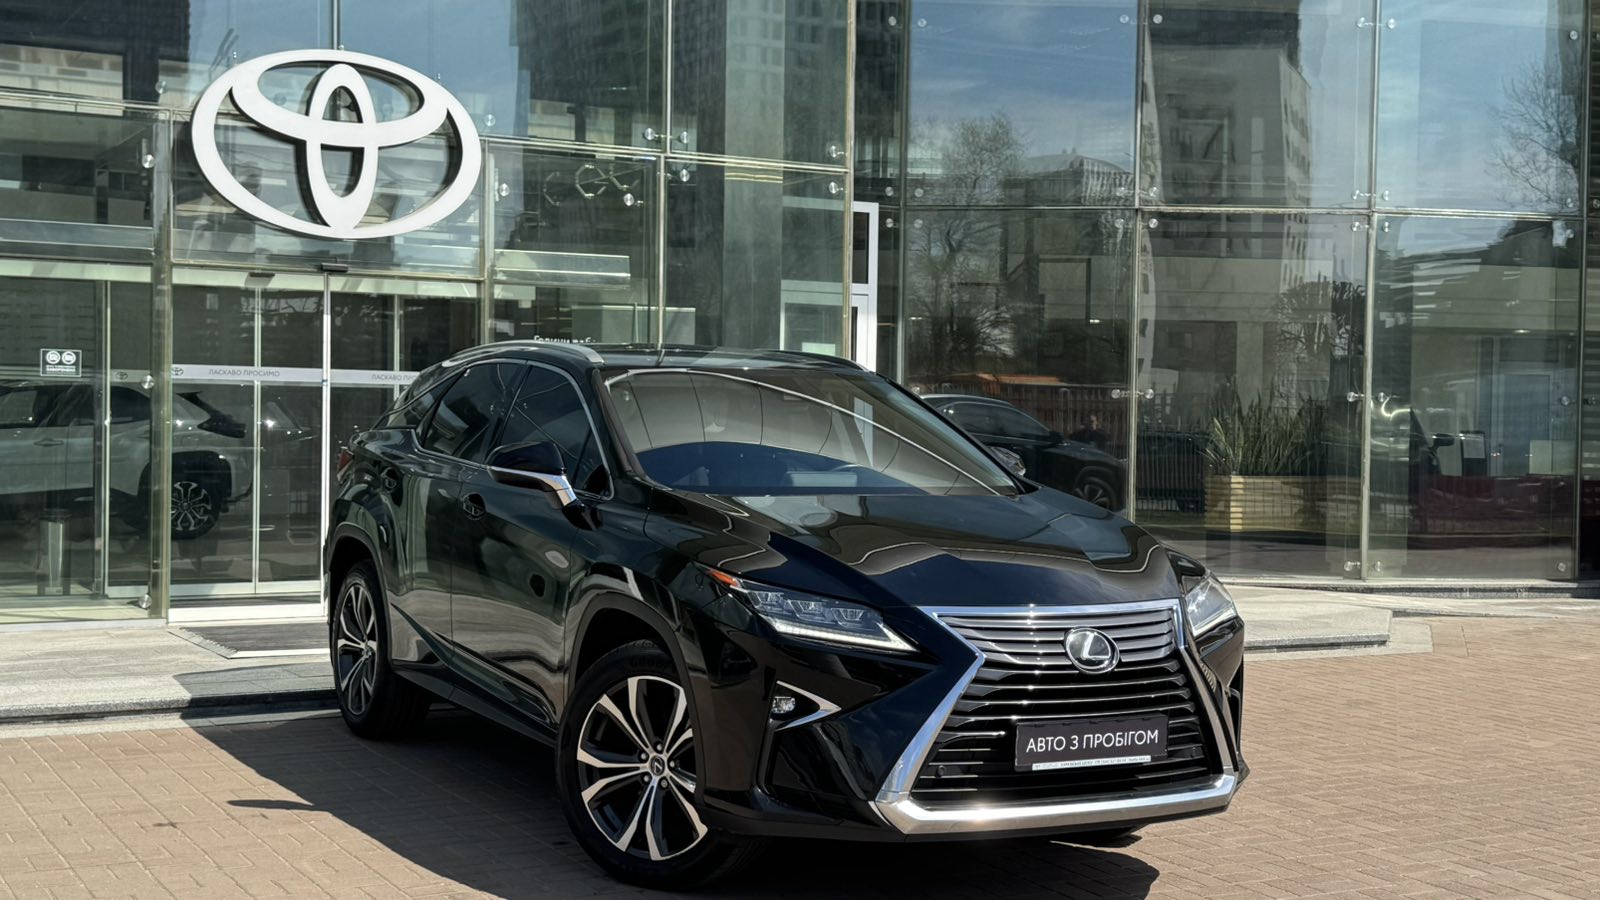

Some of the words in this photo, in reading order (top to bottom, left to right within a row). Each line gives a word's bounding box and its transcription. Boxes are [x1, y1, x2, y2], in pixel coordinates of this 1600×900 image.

[208, 368, 242, 376] ЛАСКАВО
[243, 369, 281, 377] ПРОСИМО
[1026, 736, 1066, 753] АВТО
[1083, 729, 1159, 749] ПРОБІГОМ
